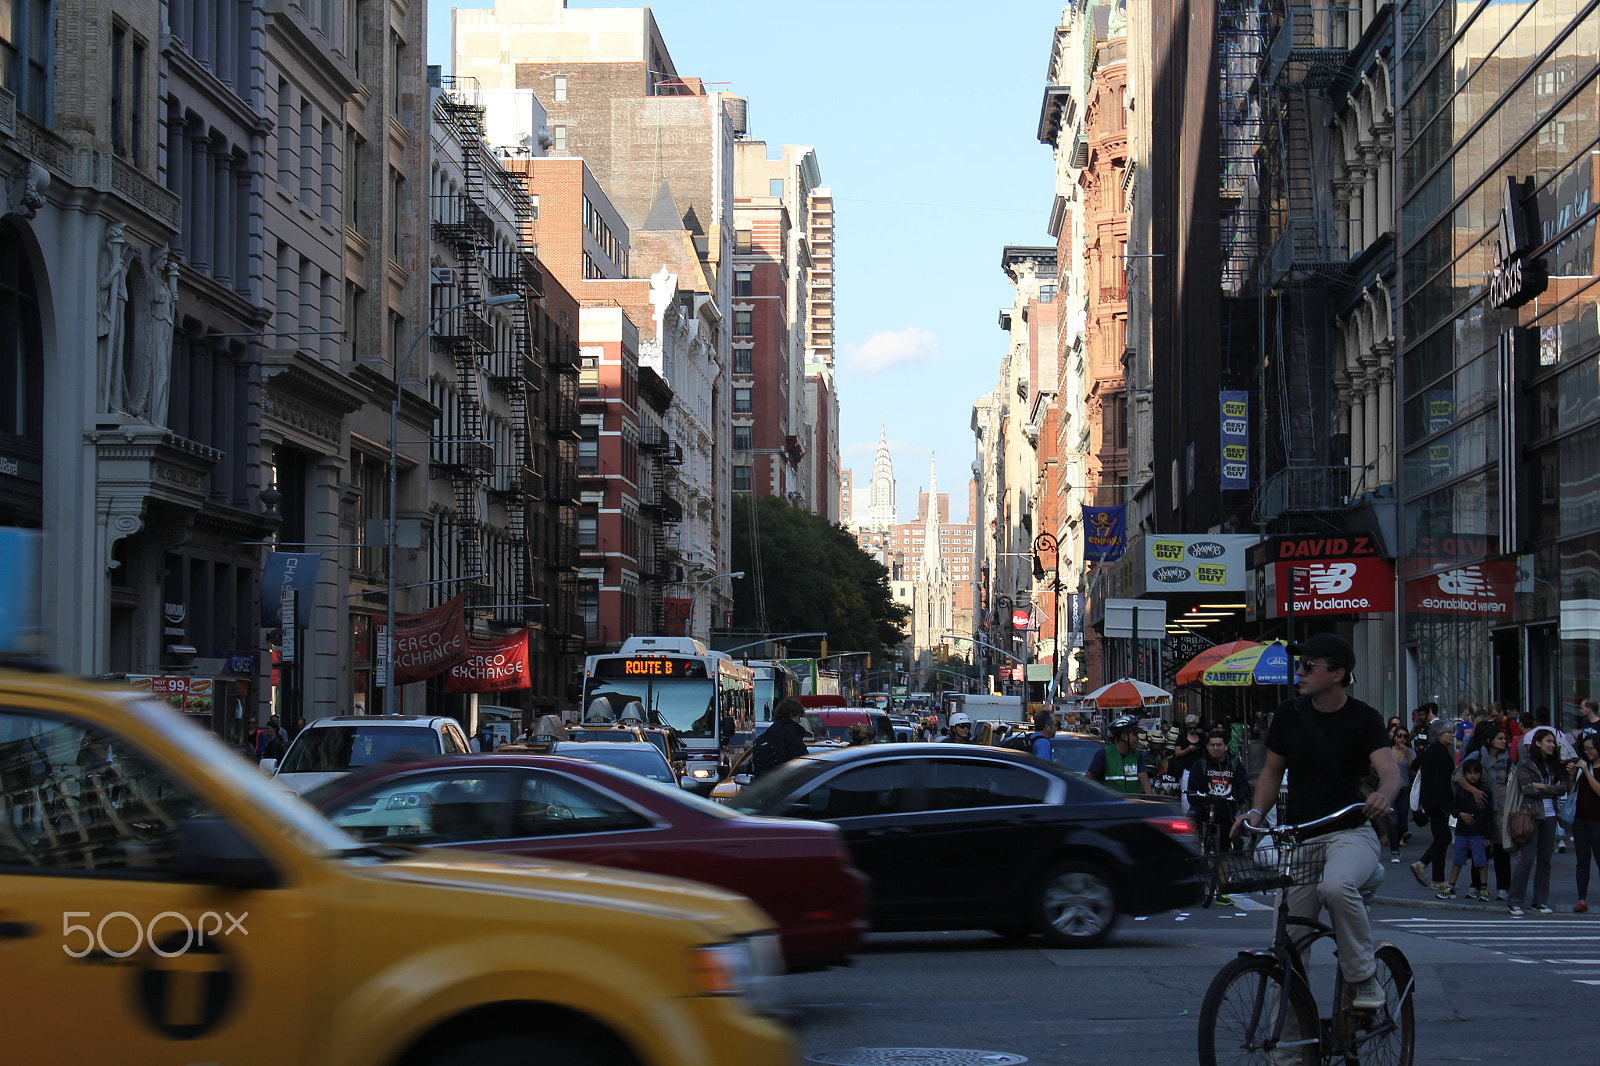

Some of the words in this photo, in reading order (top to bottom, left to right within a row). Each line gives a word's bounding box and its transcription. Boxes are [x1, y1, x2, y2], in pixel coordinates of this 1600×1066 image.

[1156, 544, 1183, 552] BEST
[1280, 538, 1349, 558] DAVID
[1198, 567, 1225, 575] BEST
[452, 661, 524, 680] EXCHANGE
[626, 661, 662, 675] ROUTE
[665, 661, 673, 675] B
[1205, 672, 1250, 682] SABRETT
